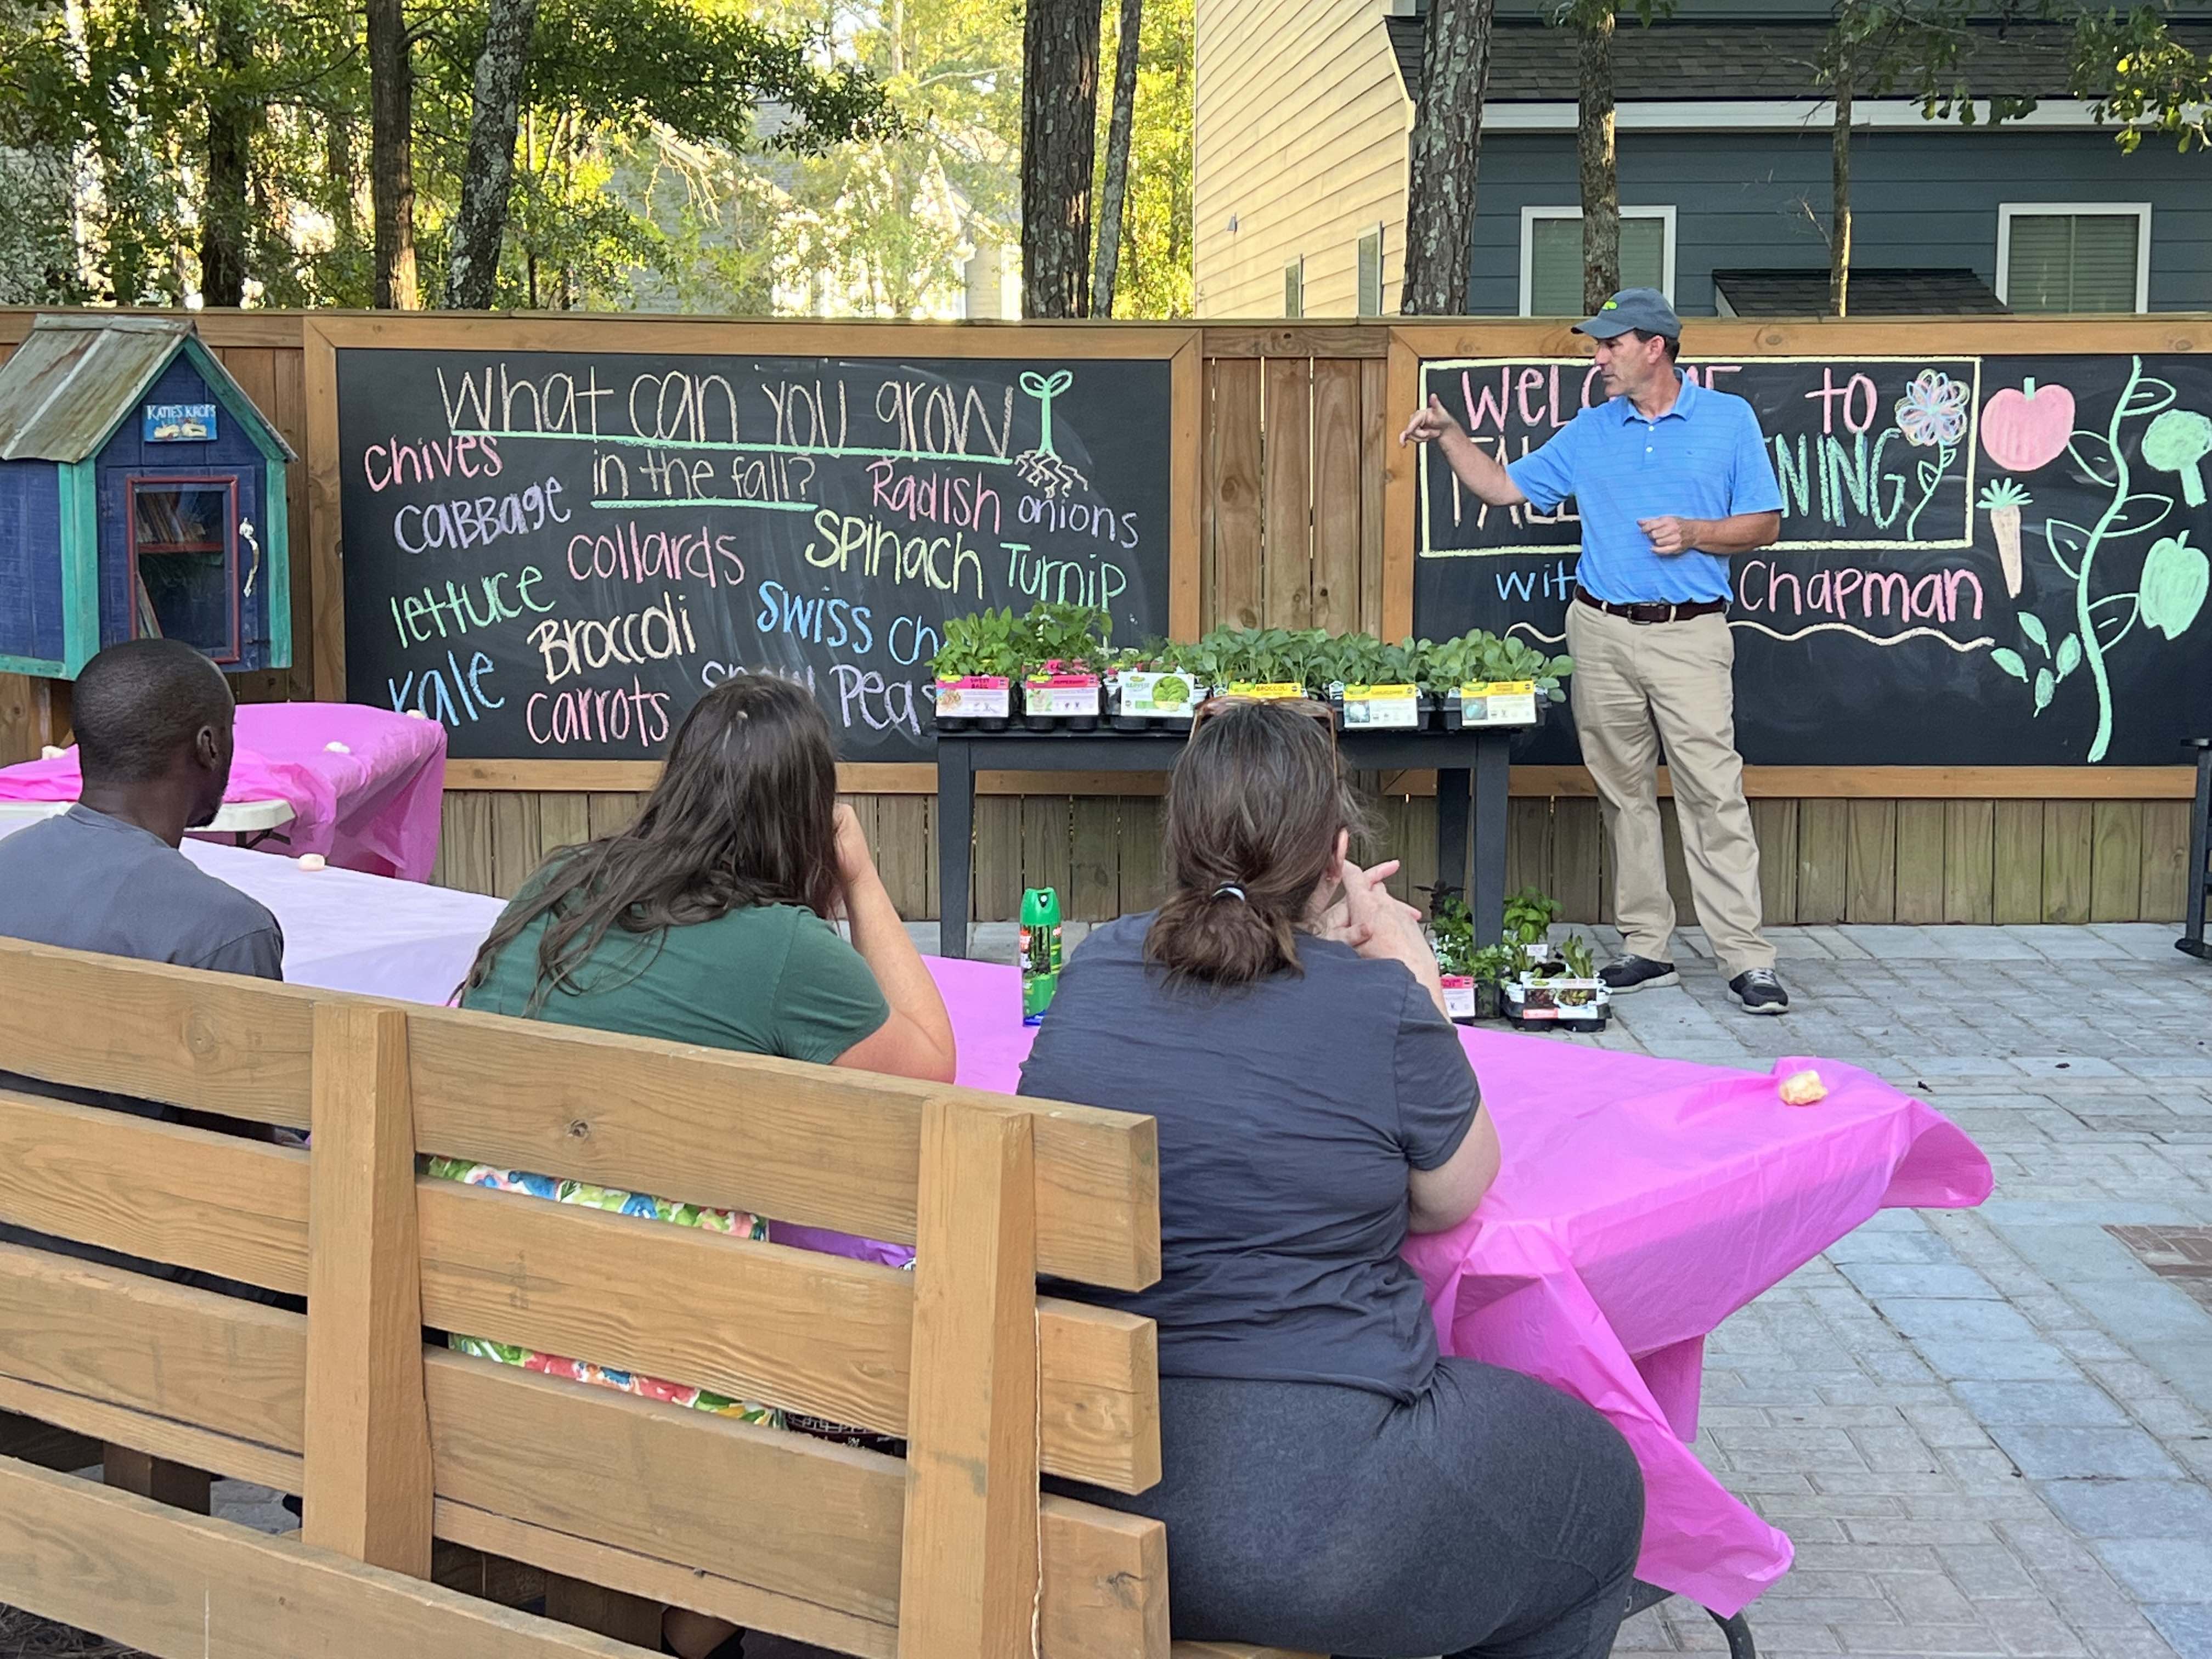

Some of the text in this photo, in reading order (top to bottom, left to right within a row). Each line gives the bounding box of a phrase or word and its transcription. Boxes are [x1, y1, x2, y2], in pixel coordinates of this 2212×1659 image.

[437, 363, 614, 442] What
[629, 371, 738, 443] can
[593, 449, 816, 501] in the fall?
[865, 459, 1000, 534] Radish
[1018, 494, 1139, 549] onions
[391, 566, 556, 648] lettuce
[526, 591, 696, 684] Broccoli
